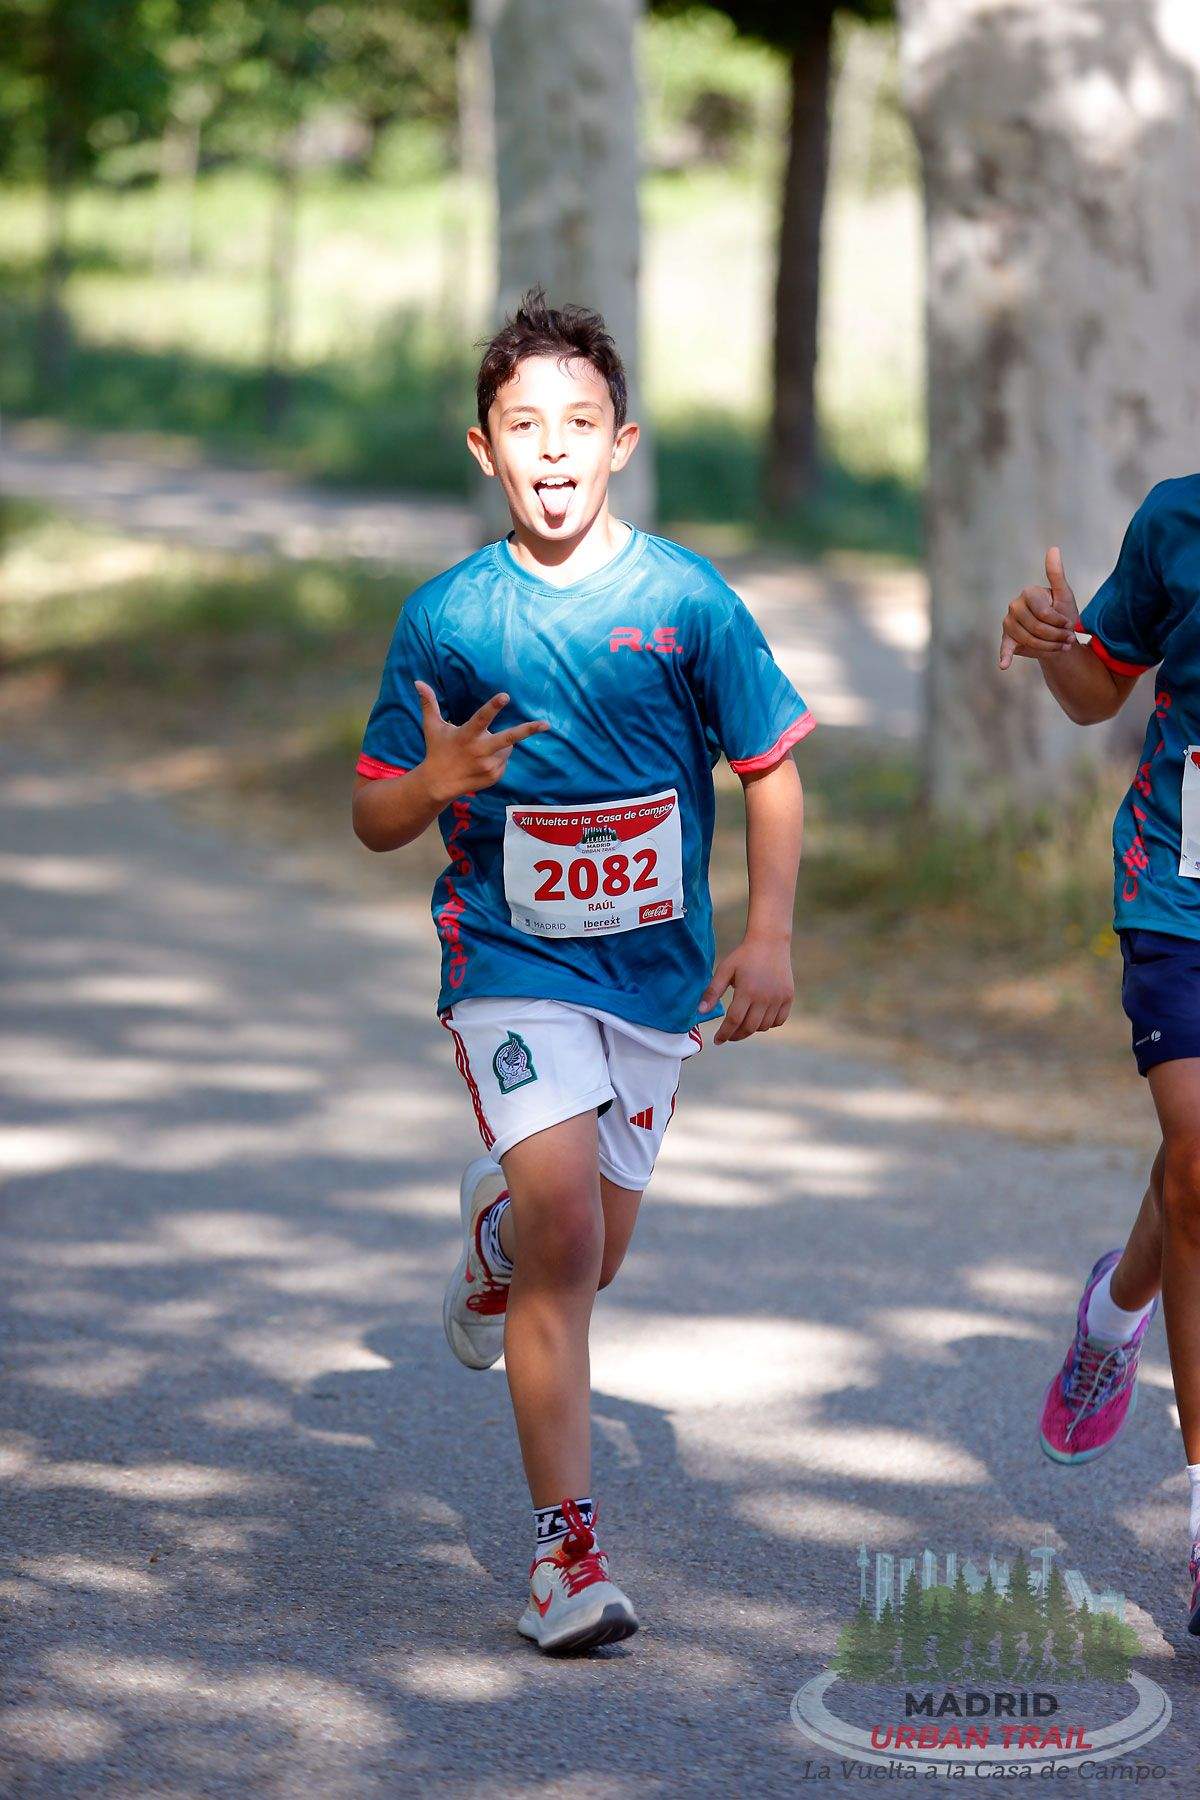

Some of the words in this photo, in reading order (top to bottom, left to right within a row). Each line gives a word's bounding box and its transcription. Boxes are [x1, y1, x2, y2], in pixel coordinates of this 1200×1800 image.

[609, 627, 683, 653] R.S.
[520, 816, 533, 826] XII
[536, 816, 568, 826] Vuelta
[571, 818, 579, 826] a
[581, 815, 592, 825] la
[596, 813, 622, 824] Casa
[624, 810, 637, 820] de
[638, 803, 674, 817] Campo
[533, 848, 659, 901] 2082
[588, 900, 616, 912] RAÚL
[533, 921, 567, 930] MADRID
[583, 916, 621, 928] Iberext
